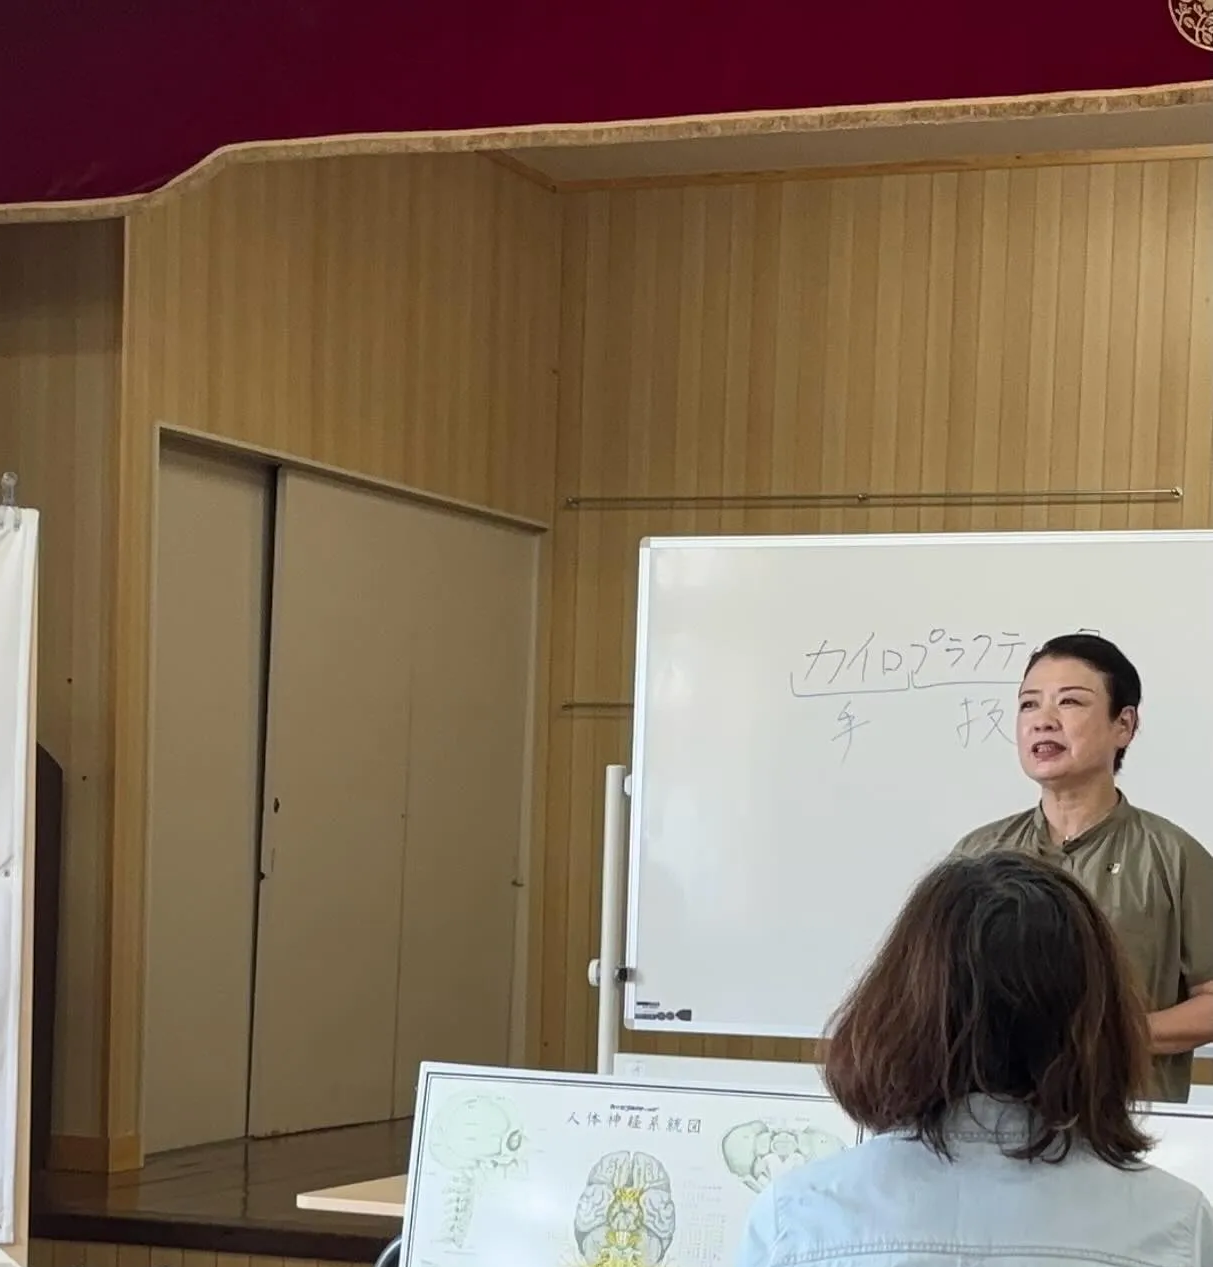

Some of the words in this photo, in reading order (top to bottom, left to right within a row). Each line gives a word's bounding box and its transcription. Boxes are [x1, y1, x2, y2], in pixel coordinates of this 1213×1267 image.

[803, 627, 1100, 685] カイロプラクテ
[830, 700, 871, 765] 手
